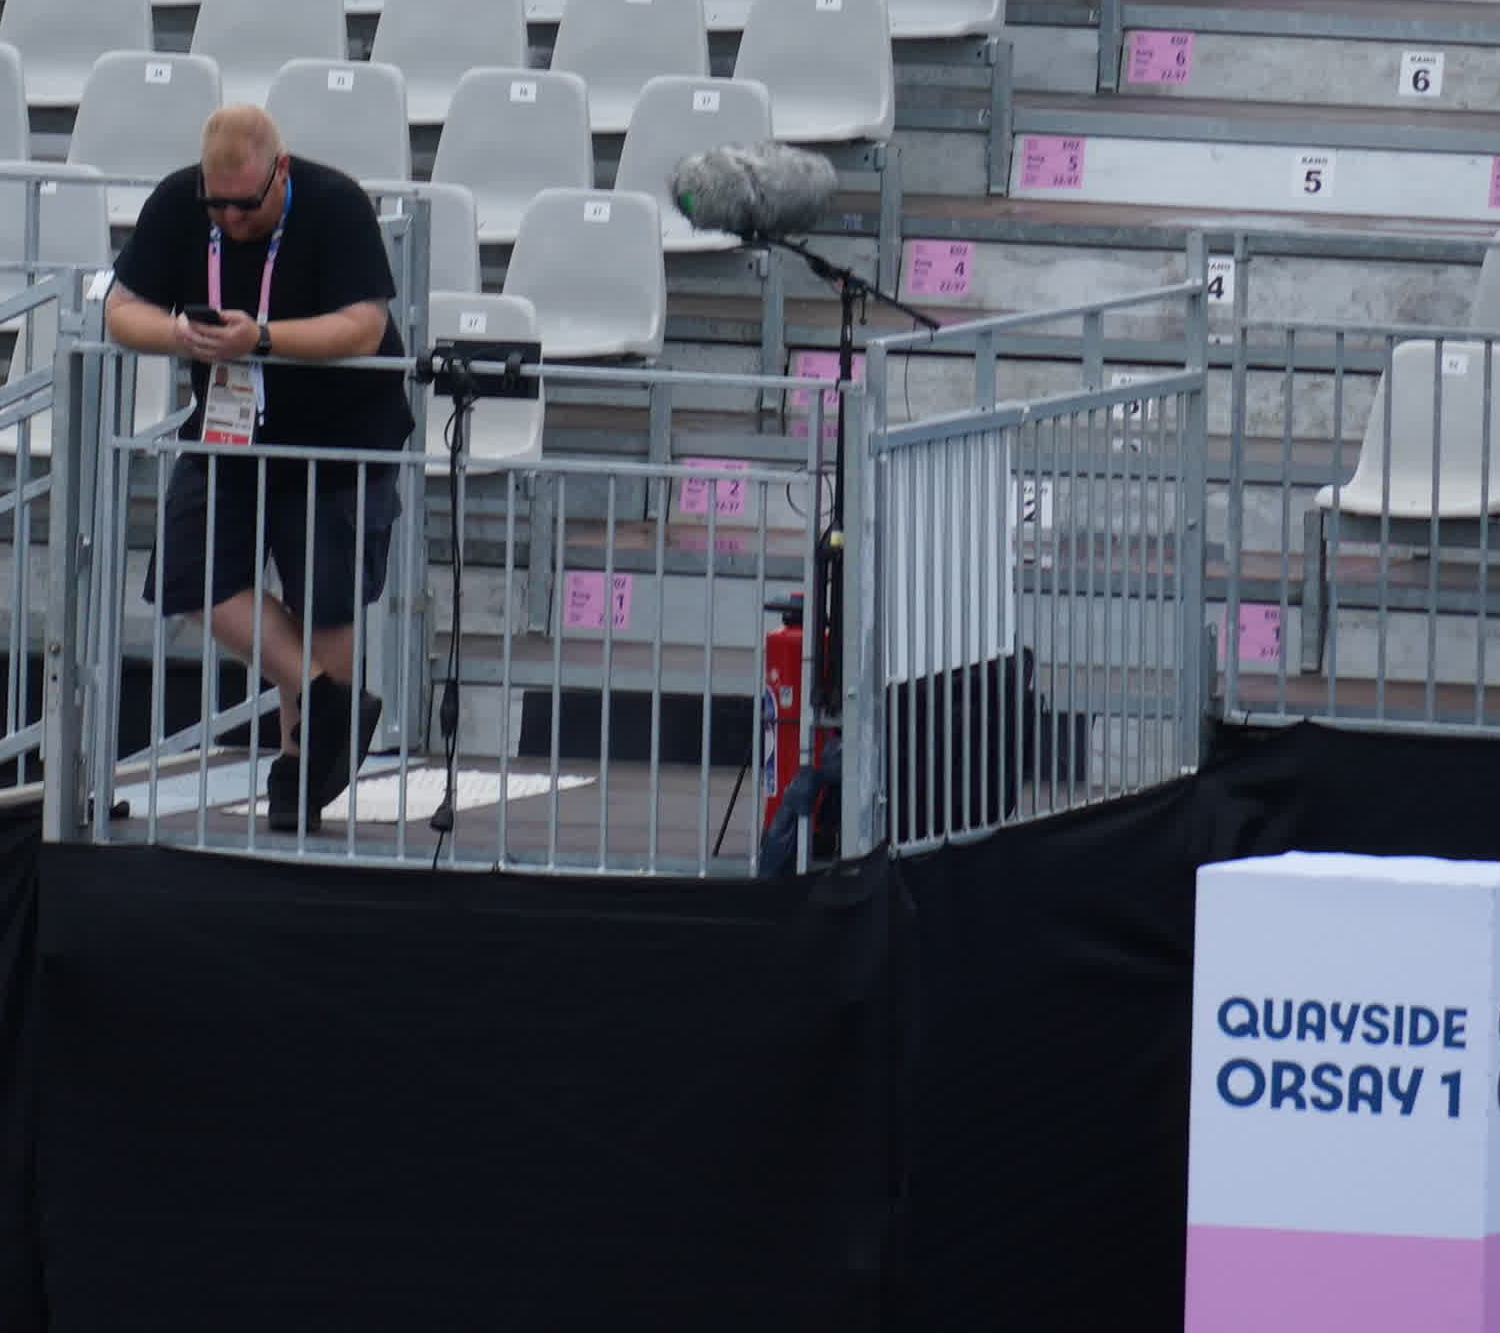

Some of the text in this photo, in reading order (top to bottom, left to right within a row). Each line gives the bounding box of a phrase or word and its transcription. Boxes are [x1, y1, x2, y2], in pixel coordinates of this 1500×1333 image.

[1175, 50, 1186, 66] 6
[1411, 69, 1431, 92] 6
[1068, 155, 1078, 171] 5
[1303, 170, 1323, 194] 5
[953, 261, 965, 277] 4
[1207, 275, 1226, 301] 4
[1217, 996, 1467, 1050] QUAYSIDE
[1216, 1057, 1463, 1119] ORSAY 1
